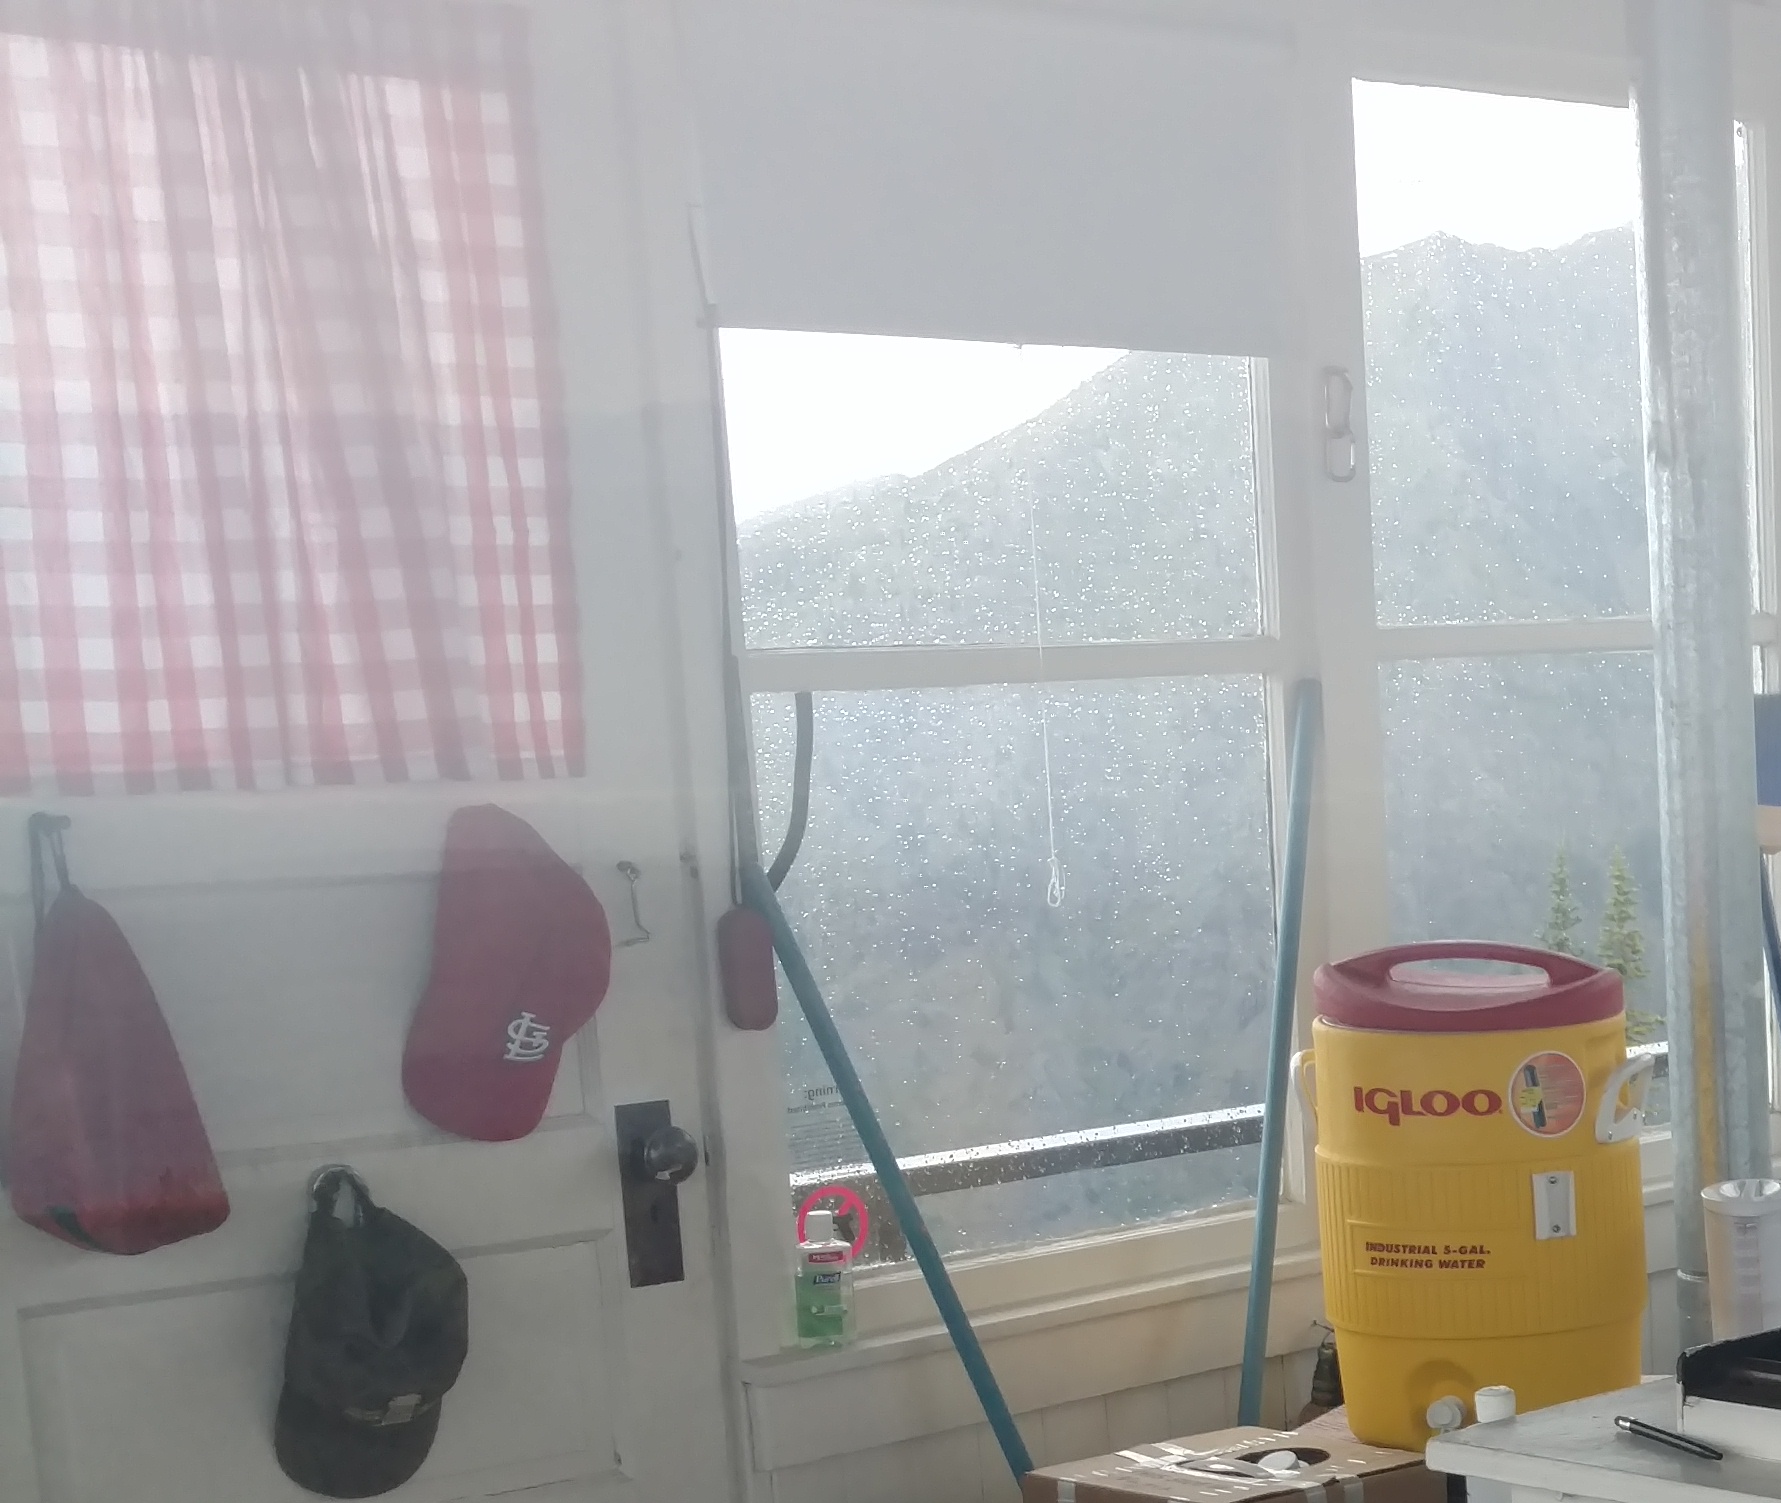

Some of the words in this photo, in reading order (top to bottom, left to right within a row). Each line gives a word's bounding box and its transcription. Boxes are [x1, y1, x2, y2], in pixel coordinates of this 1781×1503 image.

[1354, 1086, 1502, 1126] IGLOO
[1365, 1241, 1438, 1255] INDUSTRIAL
[1370, 1256, 1433, 1268] DRINKING
[1438, 1258, 1486, 1269] WATER
